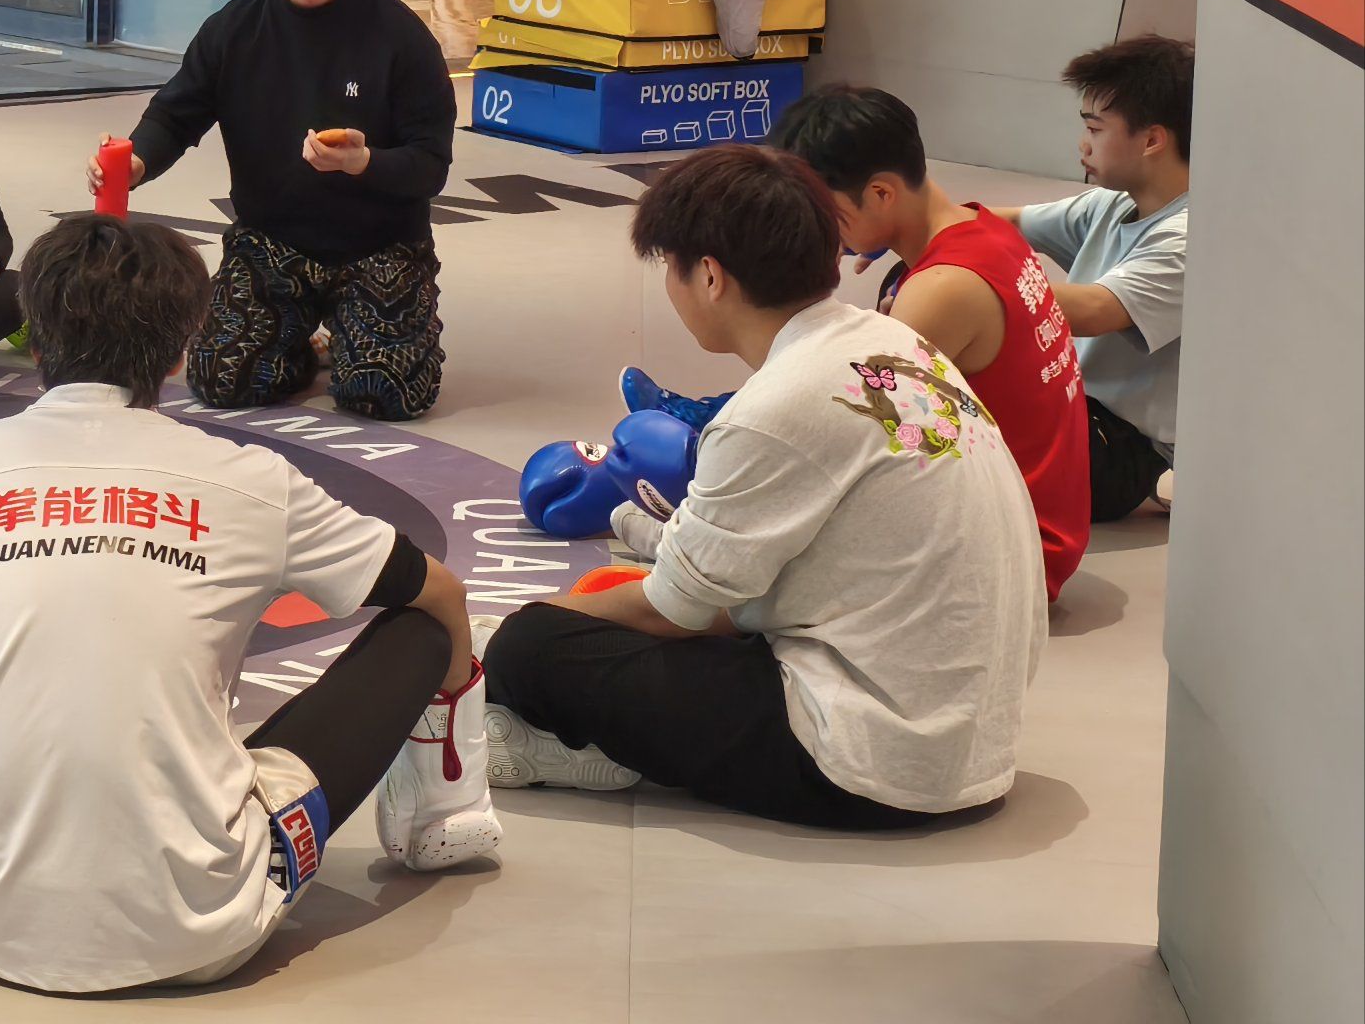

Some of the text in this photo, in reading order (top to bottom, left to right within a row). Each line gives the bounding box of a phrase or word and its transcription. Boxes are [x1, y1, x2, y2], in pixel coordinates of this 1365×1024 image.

[662, 39, 704, 60] PLYO
[482, 86, 512, 126] 02
[641, 79, 770, 105] PLYO SOFT BOX
[60, 535, 136, 557] NENG
[142, 540, 207, 576] MMA
